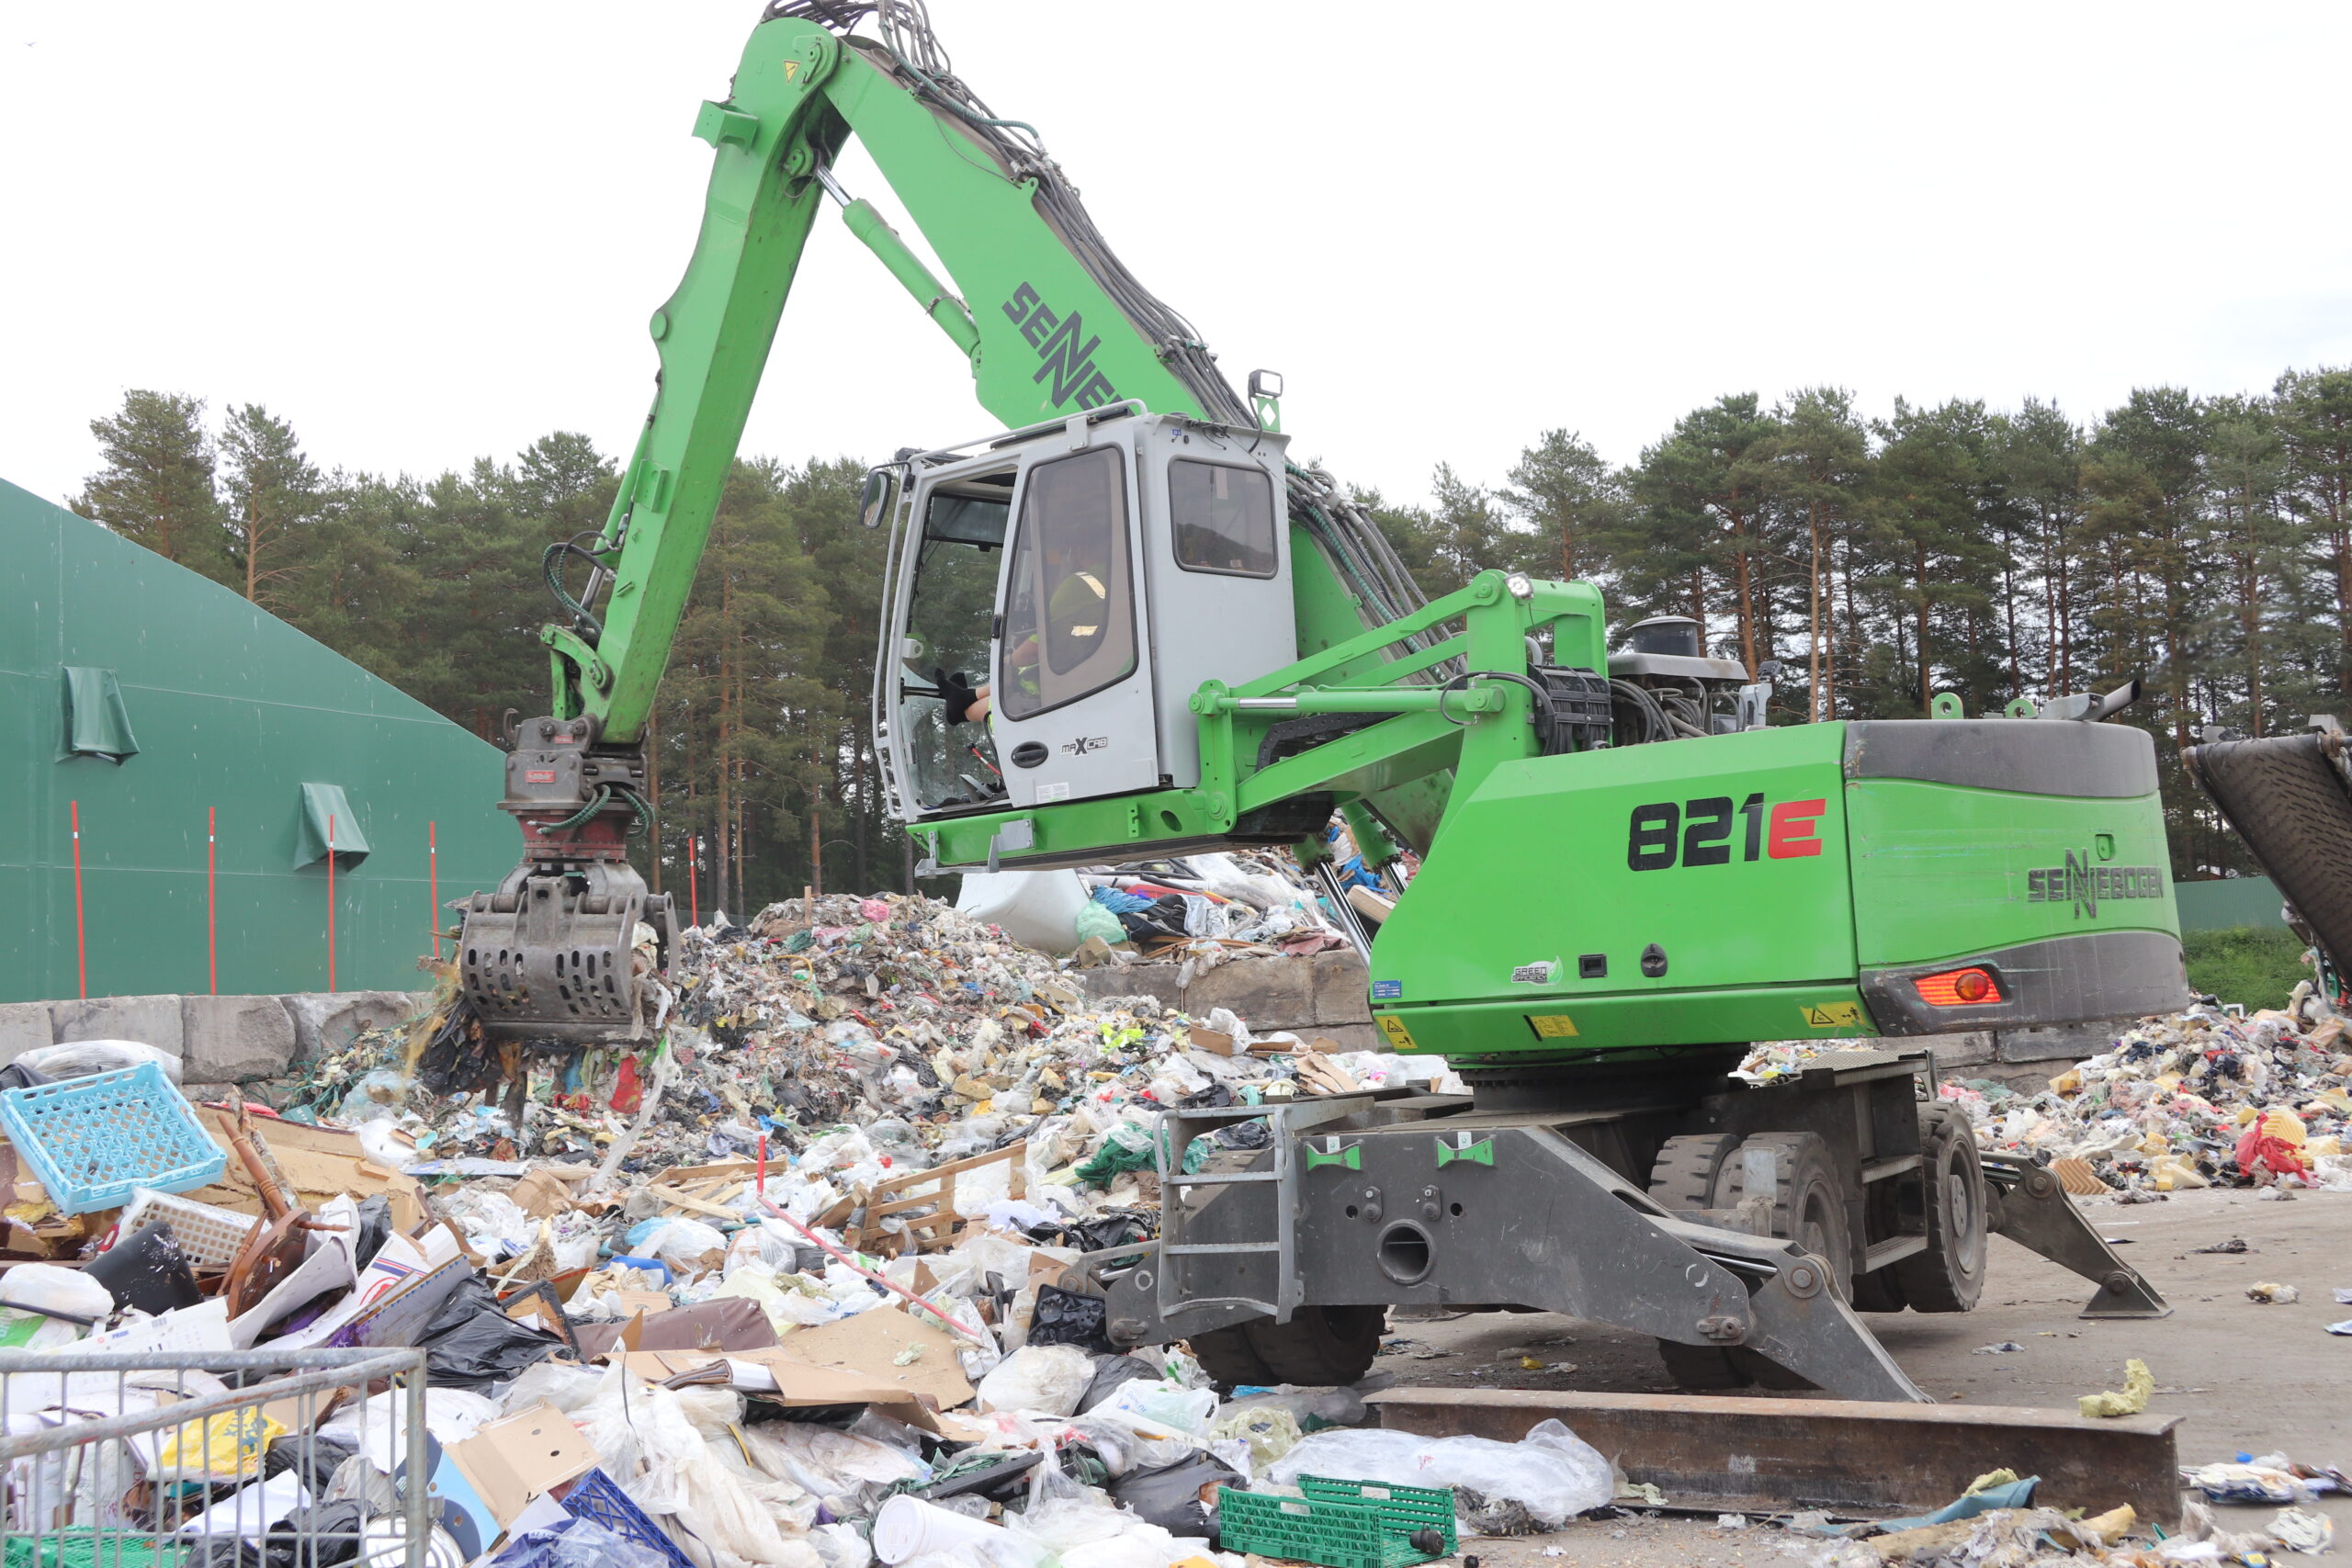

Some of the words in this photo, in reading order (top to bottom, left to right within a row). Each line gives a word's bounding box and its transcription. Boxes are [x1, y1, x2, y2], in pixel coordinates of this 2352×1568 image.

[1001, 281, 1136, 417] SENNE
[1627, 793, 1826, 872] 821E
[2028, 848, 2164, 919] SENNEBOGEN
[1515, 967, 1547, 976] GREEN
